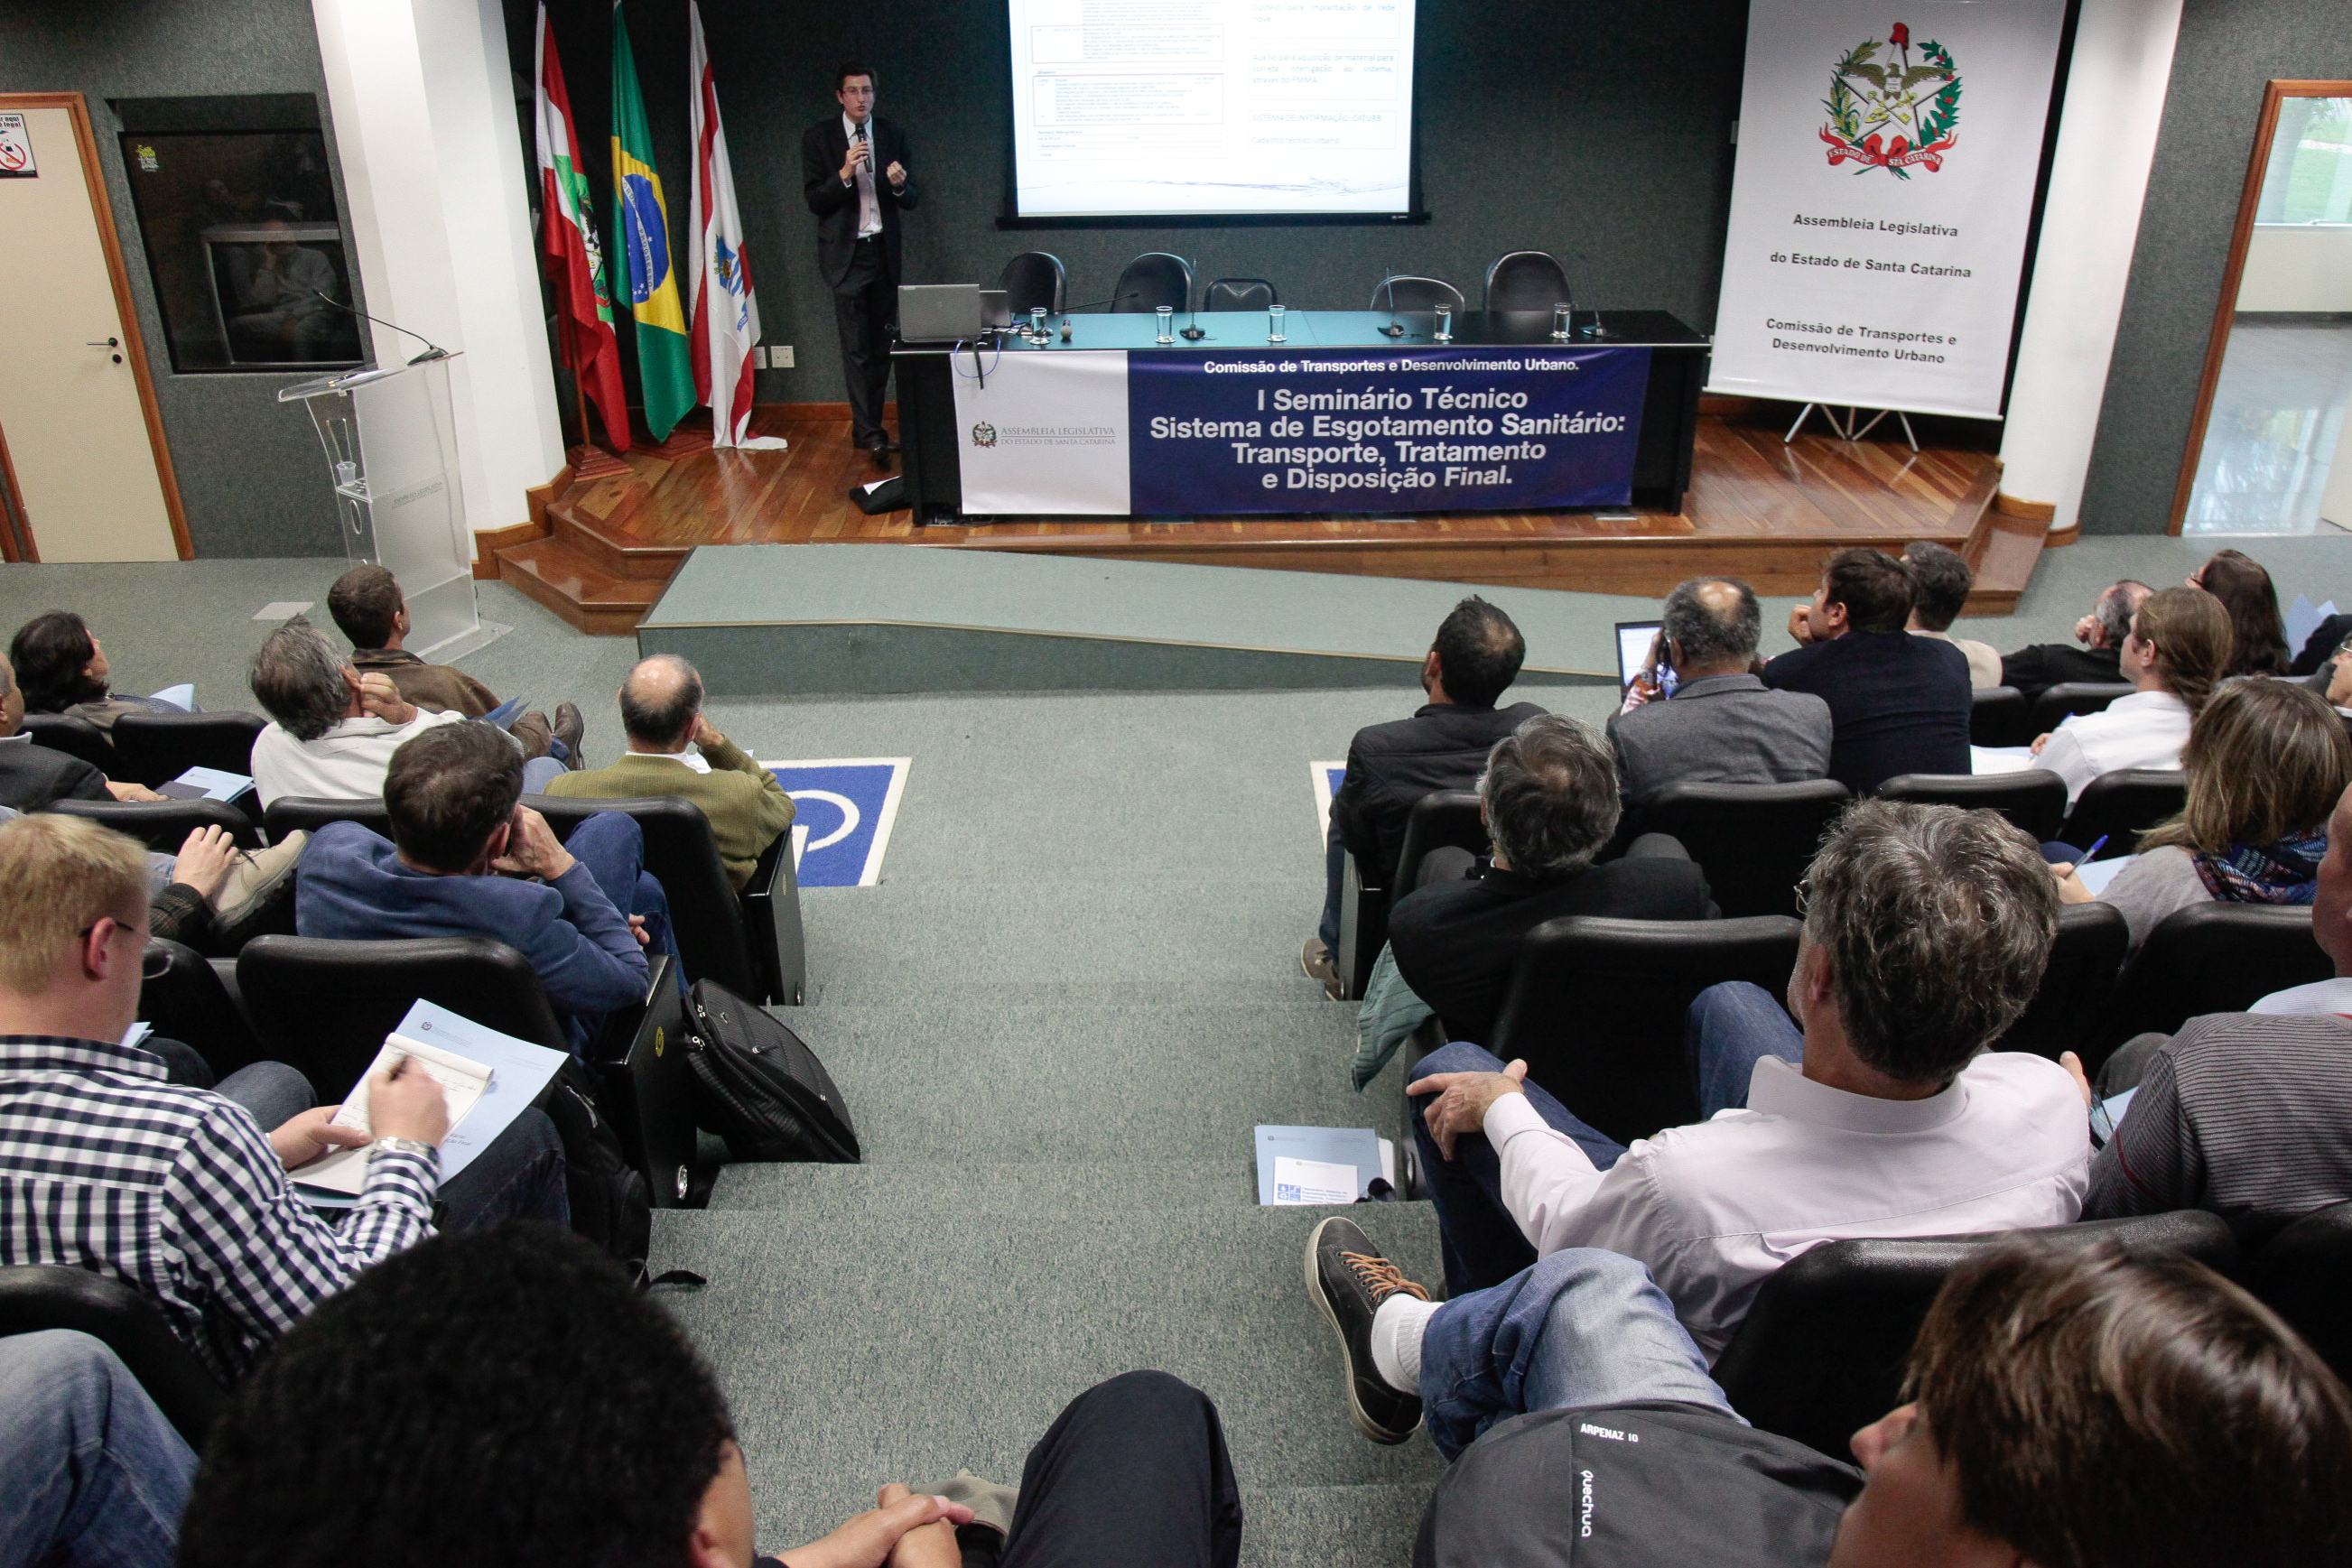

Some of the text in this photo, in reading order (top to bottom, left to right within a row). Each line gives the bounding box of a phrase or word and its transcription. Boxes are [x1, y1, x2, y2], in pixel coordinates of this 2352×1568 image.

[1793, 214, 1958, 237] Assembleia Legislativa
[1771, 252, 1972, 278] do Estado de Santa Catarina
[1766, 319, 1957, 345] Comissão de Transportes e
[1772, 338, 1945, 364] Desenvolvimento Urbano
[1204, 358, 1580, 374] Comissão de Transportes e Desenvolvimento Urbano.
[1258, 385, 1529, 411] I Seminário Técnico
[1000, 427, 1115, 436] ASSEMBLEIA LEGISLATIVA
[1150, 411, 1626, 441] Sistema de Esgotamento Sanitário:
[1231, 440, 1547, 468] Transporte, Tratamento
[1261, 464, 1513, 494] e Disposição Final.
[1580, 1423, 1624, 1441] ARPENAZ
[1580, 1470, 1594, 1537] Quechua
